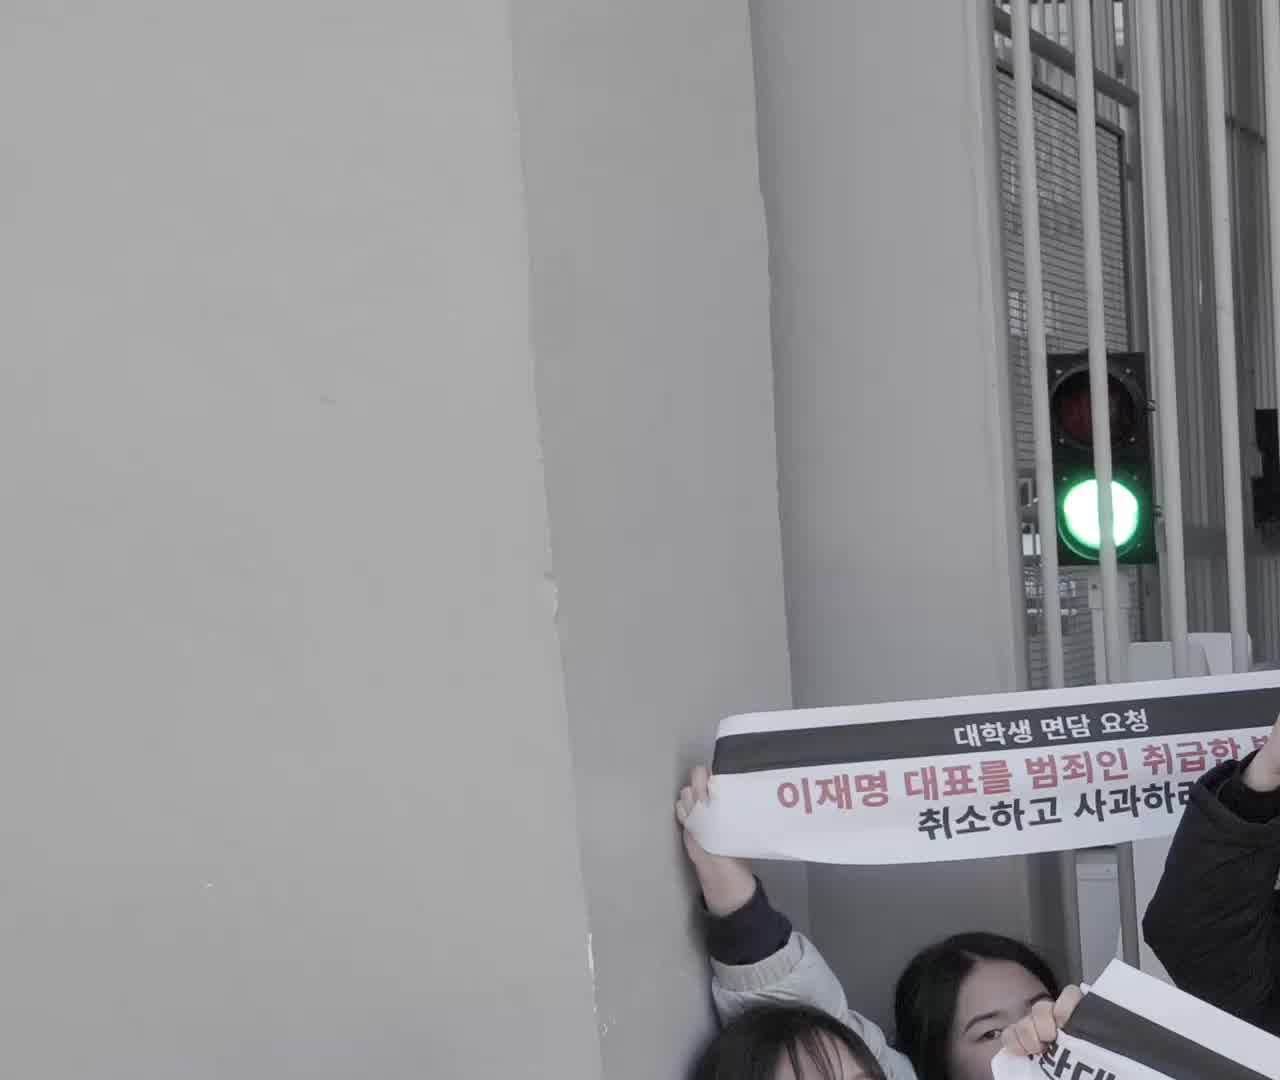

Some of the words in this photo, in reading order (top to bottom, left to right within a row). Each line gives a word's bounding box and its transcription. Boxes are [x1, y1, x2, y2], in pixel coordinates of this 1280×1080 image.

[953, 717, 1033, 748] 대학생
[1040, 712, 1091, 741] 면담
[1099, 708, 1150, 735] 요청
[776, 770, 889, 814] 이재명
[903, 759, 1012, 802] 대표를
[1024, 747, 1131, 791] 범죄인
[1142, 734, 1244, 776] 취급한
[917, 798, 1063, 841] 취소하고
